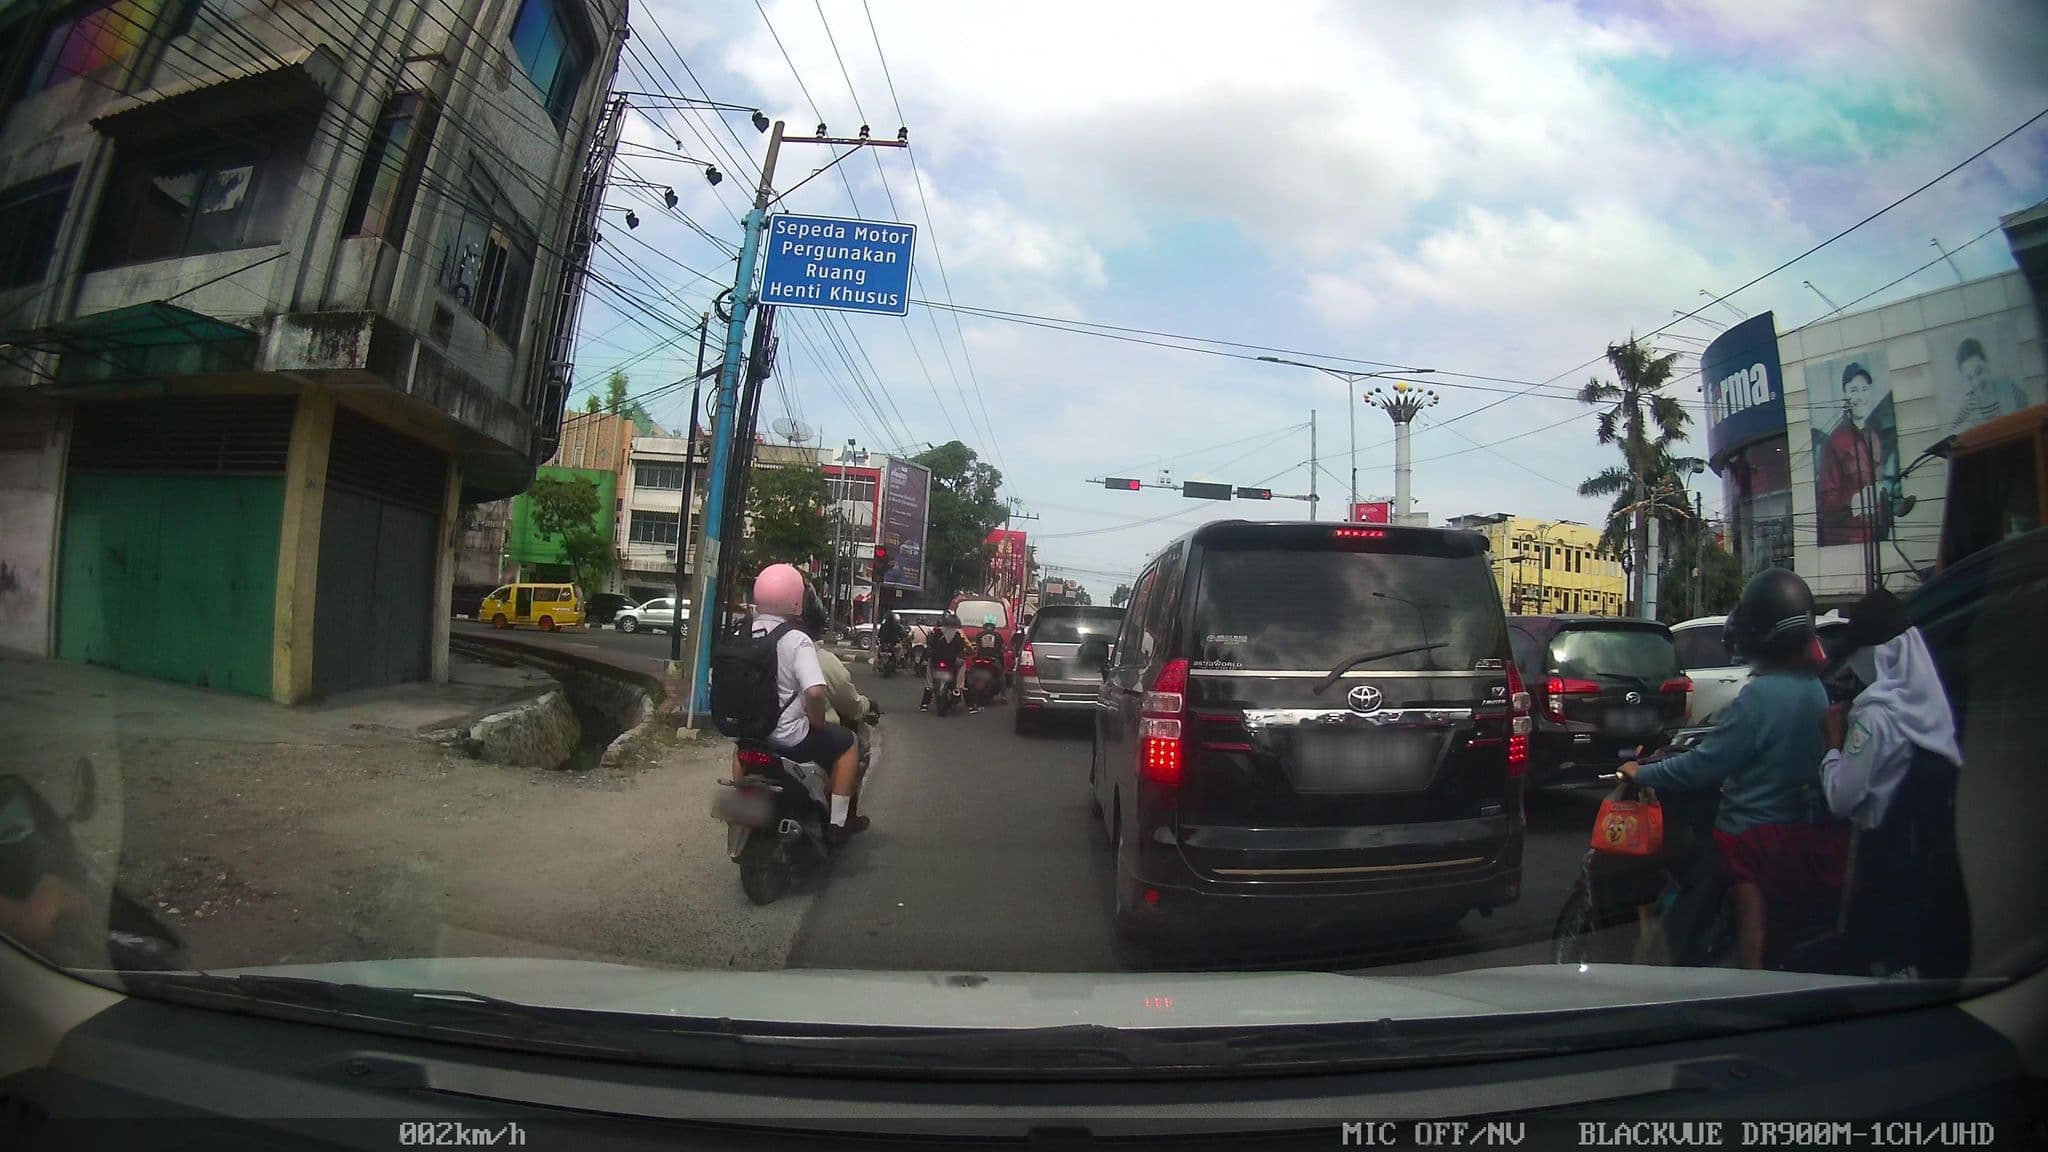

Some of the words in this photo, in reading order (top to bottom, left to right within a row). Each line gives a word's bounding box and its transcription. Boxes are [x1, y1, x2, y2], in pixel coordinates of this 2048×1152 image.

[776, 220, 845, 239] Sepeda
[854, 226, 909, 245] Motor
[782, 241, 896, 264] Pergunakan
[806, 264, 866, 285] Ruang
[770, 281, 821, 299] Henti
[829, 286, 898, 306] Khusus
